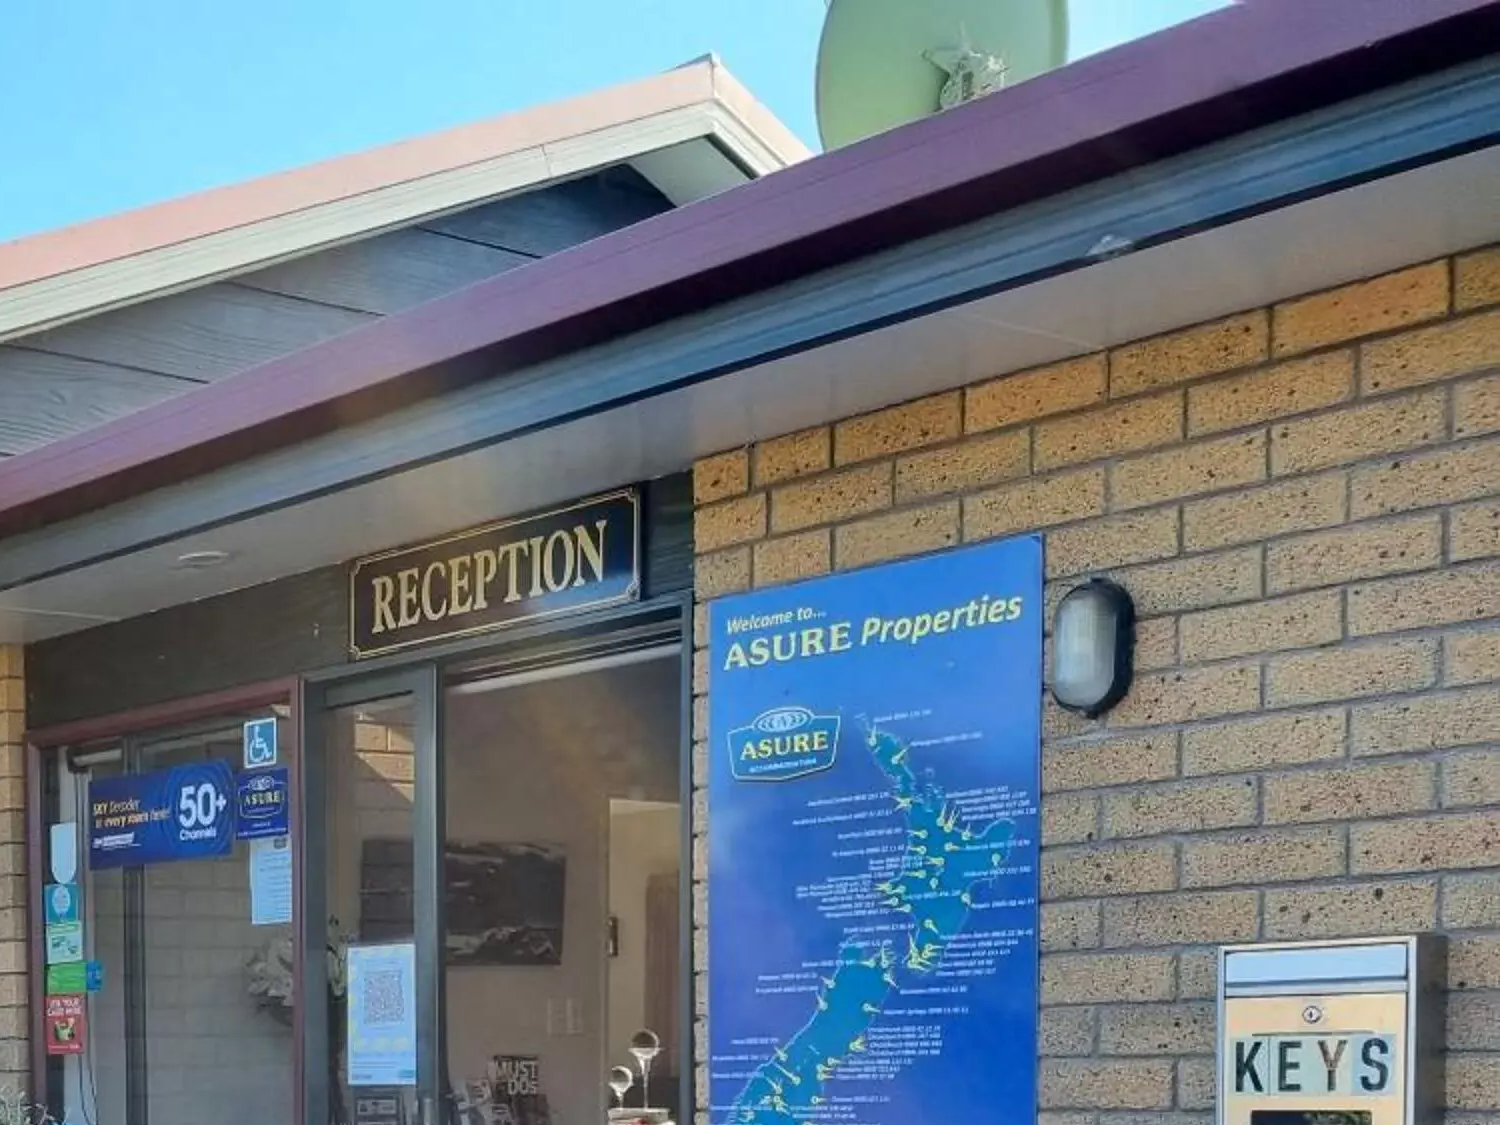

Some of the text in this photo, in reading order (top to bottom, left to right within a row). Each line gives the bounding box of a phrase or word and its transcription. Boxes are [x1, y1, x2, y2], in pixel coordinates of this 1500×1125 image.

[371, 519, 608, 634] RECEPTION
[722, 594, 1024, 671] ASURE Properties
[727, 610, 793, 635] Welcome
[739, 730, 829, 761] ASURE
[179, 782, 227, 828] 50+
[179, 827, 217, 841] Channels
[1234, 1037, 1390, 1093] KEYS
